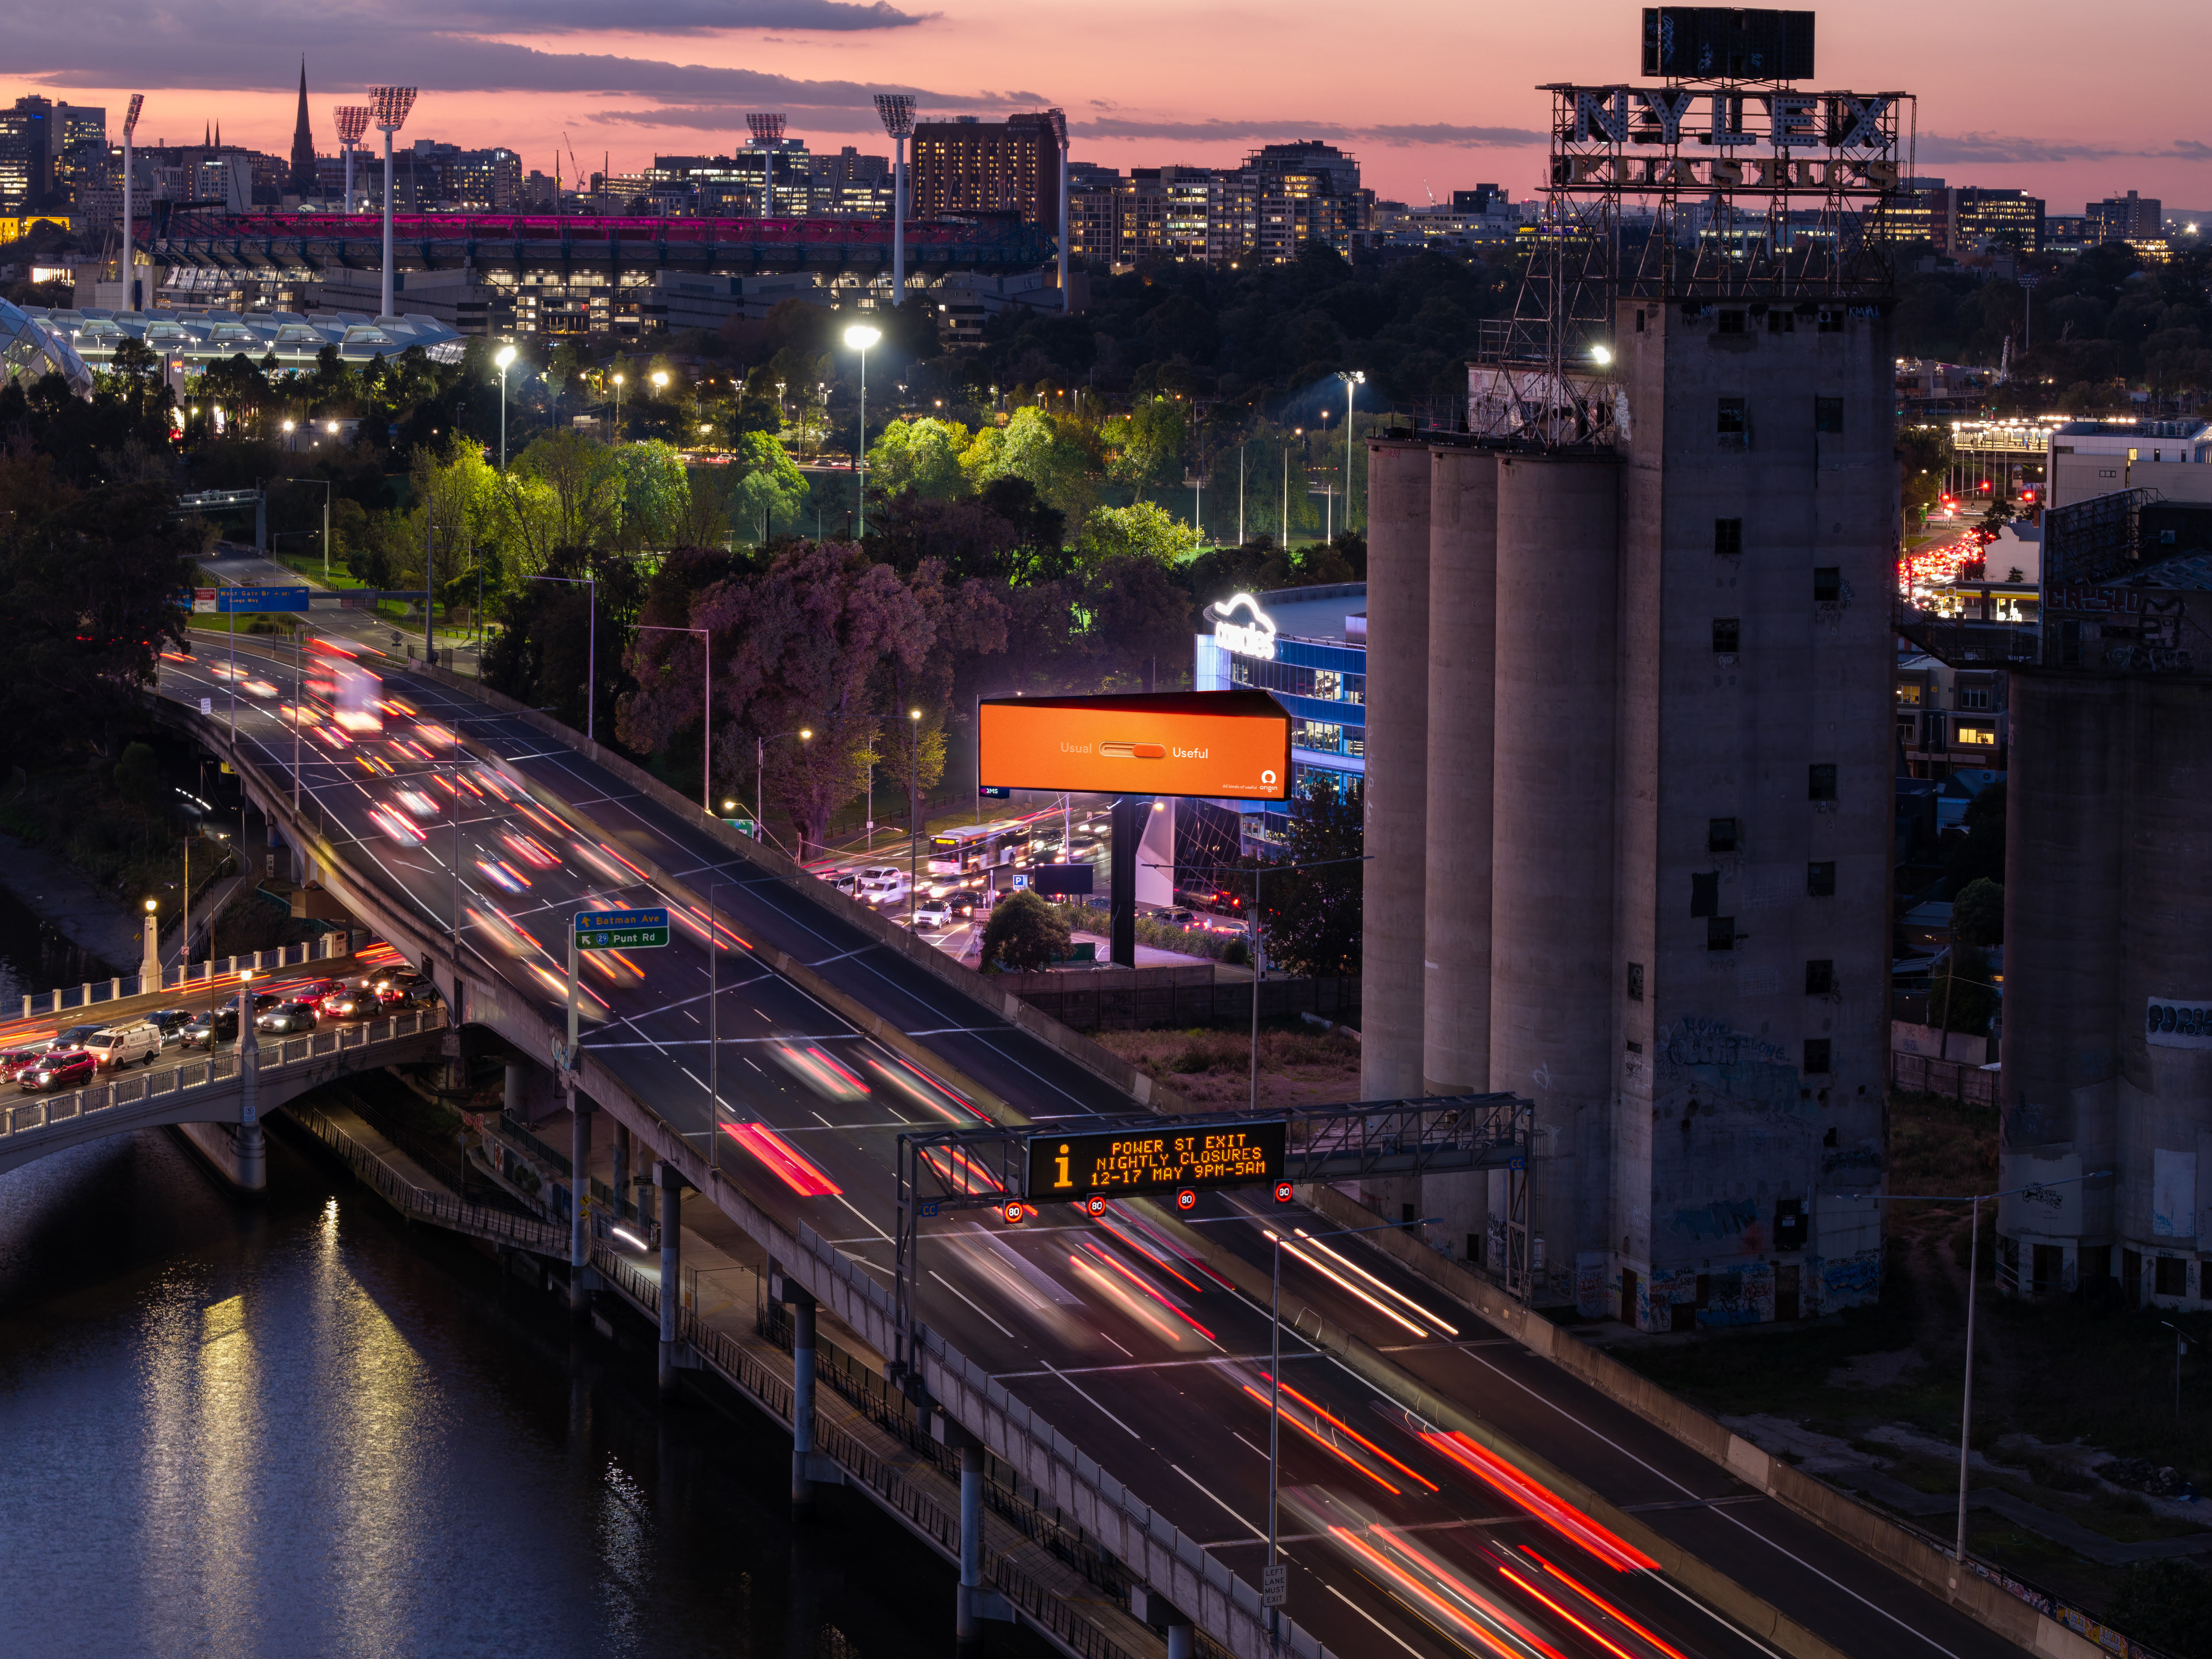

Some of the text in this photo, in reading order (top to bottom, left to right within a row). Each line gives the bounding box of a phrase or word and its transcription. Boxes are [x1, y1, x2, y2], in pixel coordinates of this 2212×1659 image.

[1575, 90, 1892, 148] NYLEX
[1569, 155, 1898, 189] PLASTICS
[1060, 742, 1208, 759] Usual Useful
[642, 933, 655, 941] Rd
[1113, 1134, 1246, 1155] POWER ST EXIT
[1097, 1147, 1262, 1171] NIGHTLY CLOSURES
[1511, 1159, 1522, 1168] CC
[1091, 1161, 1265, 1186] 12-17 MAY 9PM-5AM
[1182, 1195, 1192, 1204] 80
[1279, 1187, 1289, 1196] 80
[923, 1206, 935, 1215] CC
[1092, 1202, 1102, 1210] 80
[2099, 1627, 2120, 1644] A DAY TO
